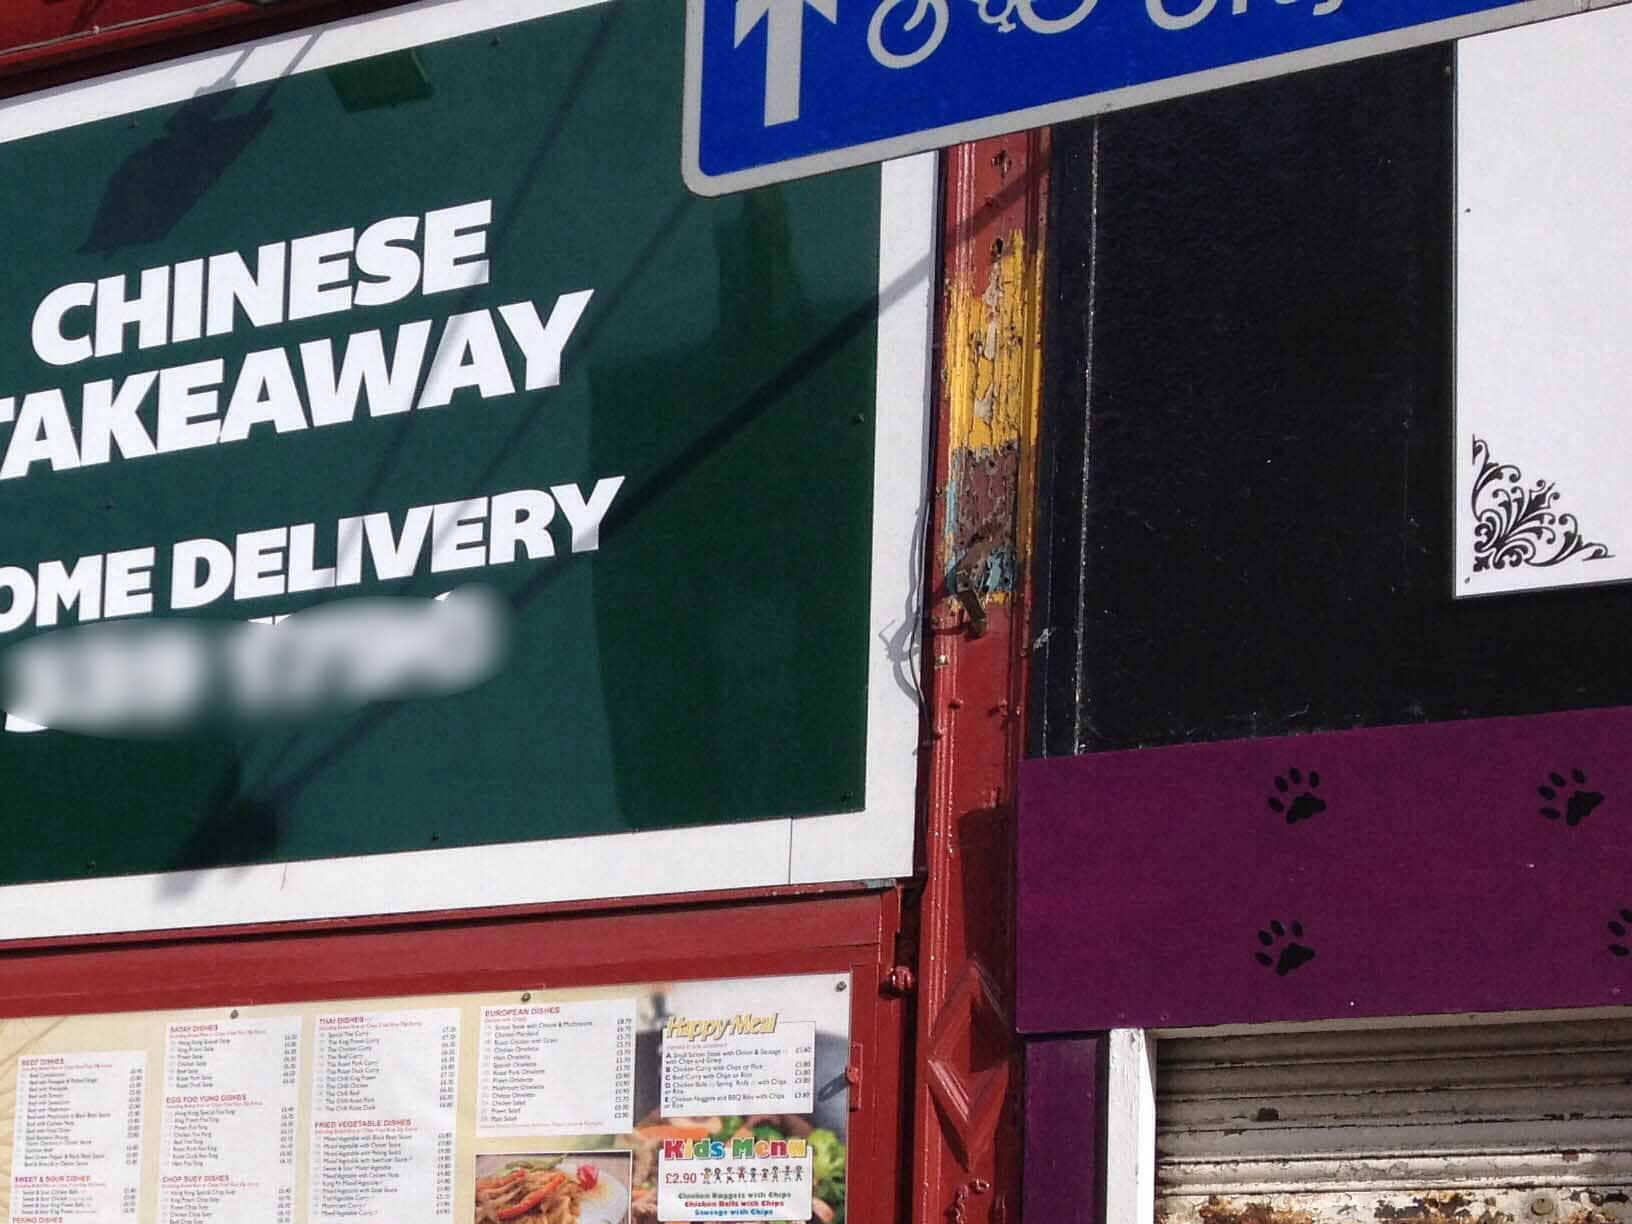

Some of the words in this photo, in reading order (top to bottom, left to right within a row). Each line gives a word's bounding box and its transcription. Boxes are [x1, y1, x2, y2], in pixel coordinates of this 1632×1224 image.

[30, 200, 492, 366] CHINESE
[170, 476, 626, 609] DELIVERY
[485, 1008, 529, 1017] EUROPEAN
[531, 1007, 560, 1015] DISHES
[665, 1014, 731, 1042] Happy
[729, 1012, 779, 1036] Meal
[664, 1138, 726, 1160] Kids
[732, 1136, 807, 1159] Menu
[666, 1173, 697, 1184] £2.90
[678, 1192, 710, 1200] Chicken
[751, 1208, 773, 1216] Chips
